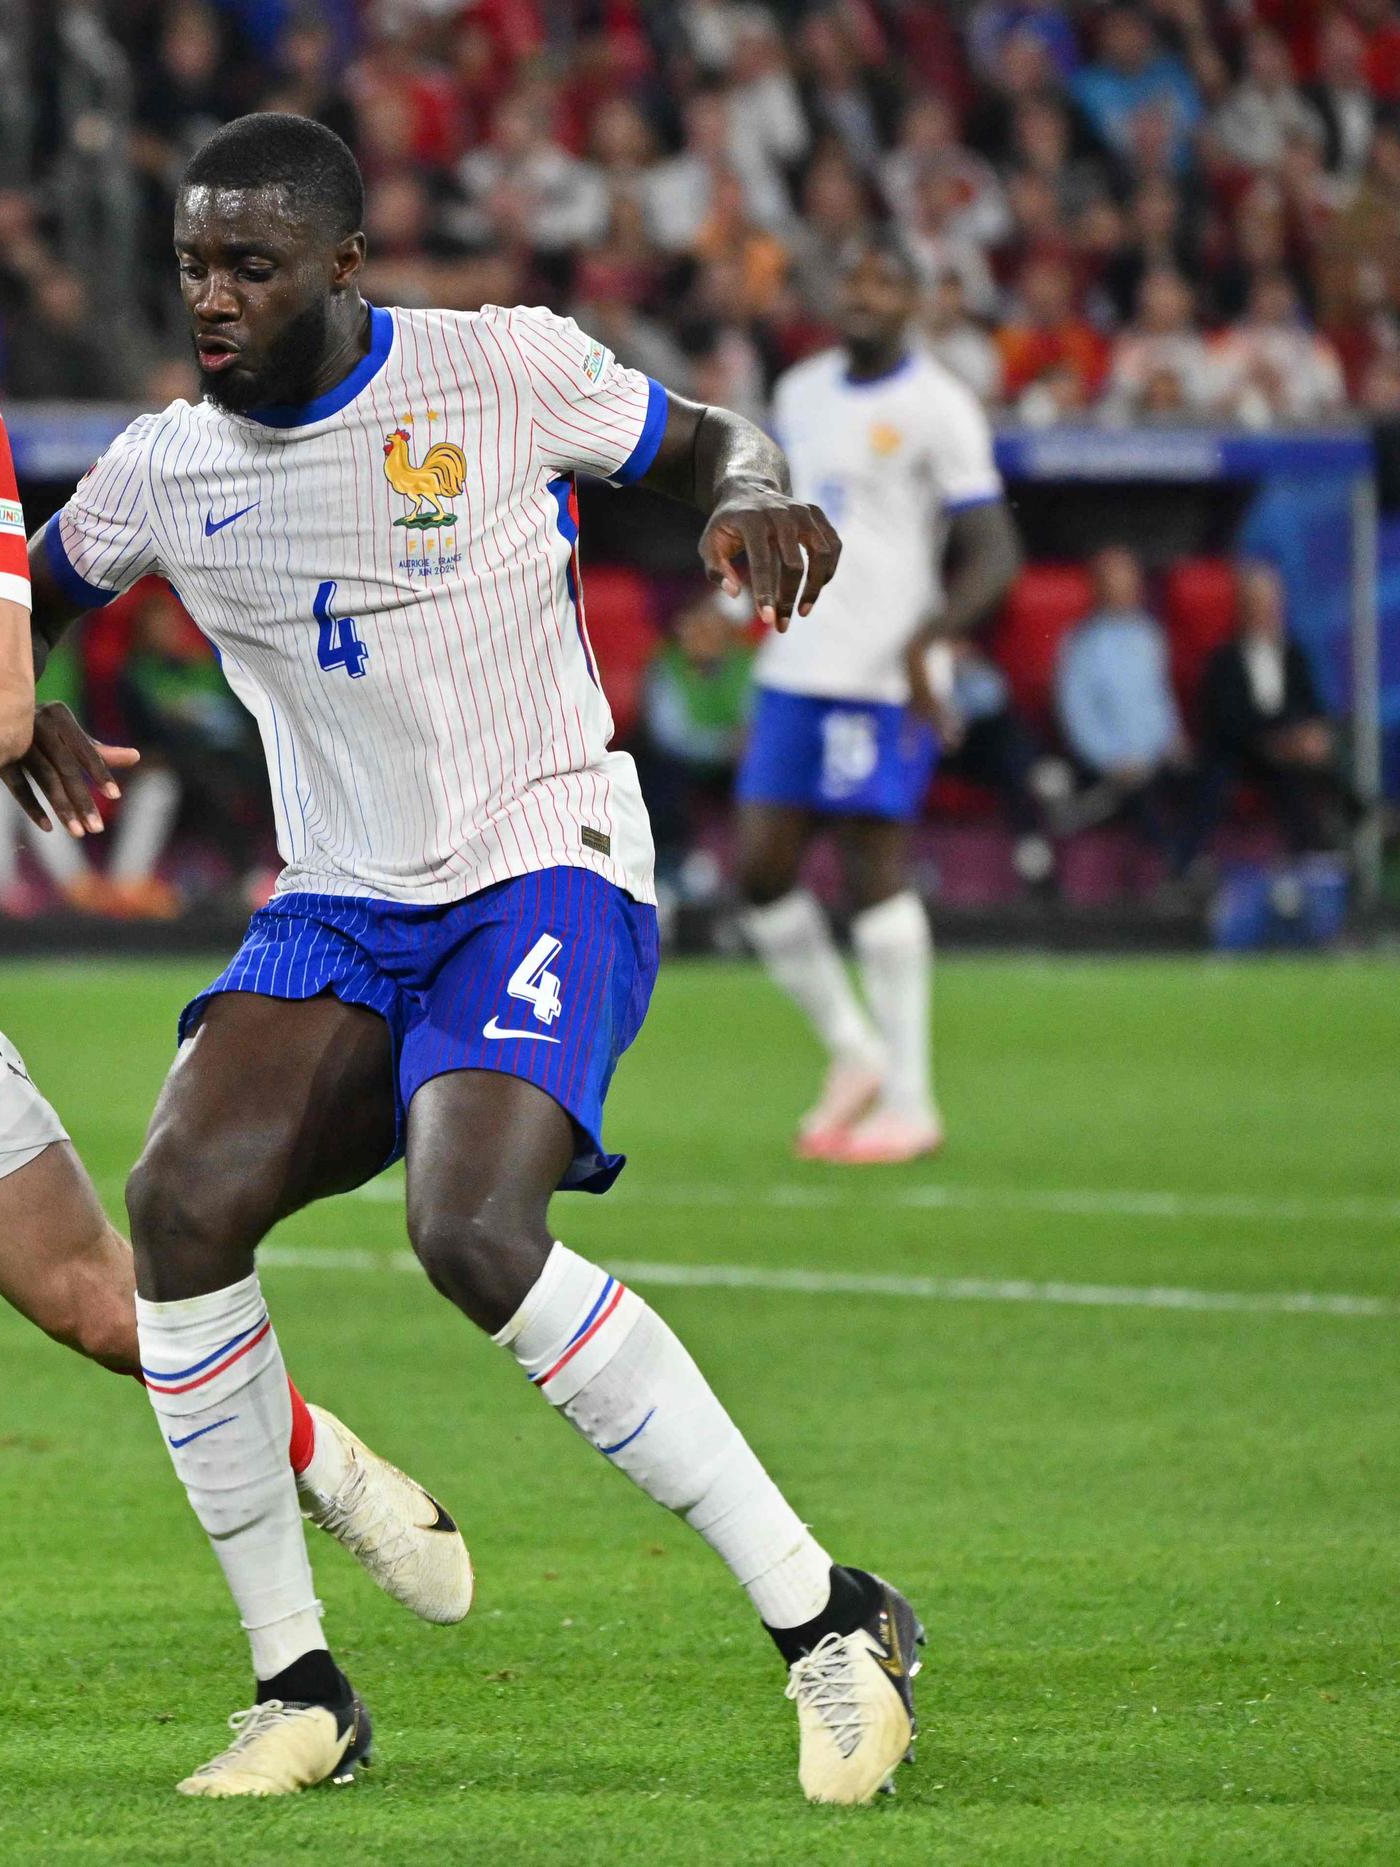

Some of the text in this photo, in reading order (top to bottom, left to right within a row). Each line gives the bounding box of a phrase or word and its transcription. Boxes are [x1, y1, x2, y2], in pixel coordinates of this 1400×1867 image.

[399, 558, 430, 568] AUTRICHE
[438, 553, 462, 565] FRANCE
[435, 565, 454, 575] 2024
[313, 581, 368, 679] 4
[507, 933, 562, 1025] 4
